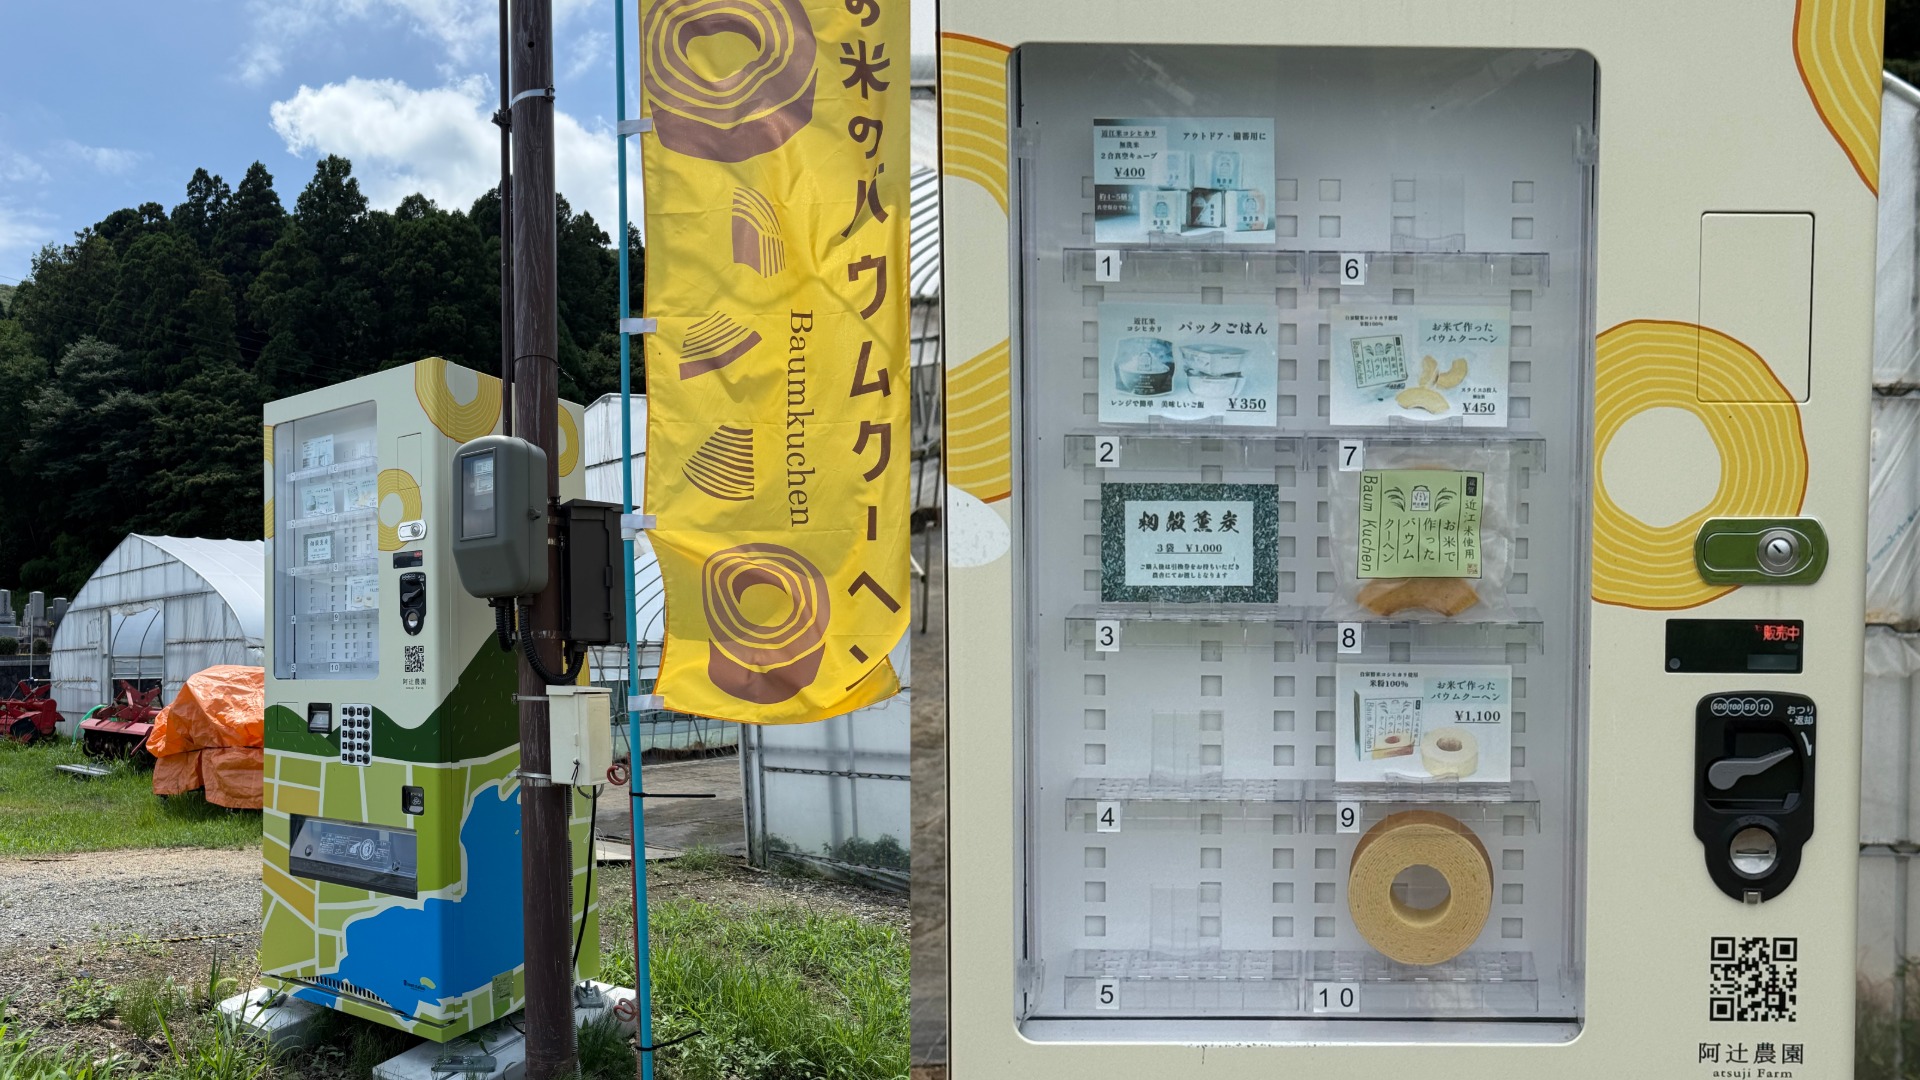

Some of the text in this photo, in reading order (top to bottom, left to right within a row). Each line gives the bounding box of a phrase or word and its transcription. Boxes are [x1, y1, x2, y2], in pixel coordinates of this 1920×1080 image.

[1101, 129, 1157, 138] 近江米コシヒカリ
[1114, 167, 1146, 178] ¥400
[1102, 256, 1111, 277] 1
[1345, 258, 1359, 280] 6
[1133, 317, 1156, 326] 近江米
[1178, 321, 1268, 335] パックごはん
[1432, 321, 1493, 333] お米で作った
[1426, 333, 1499, 343] バウムクーヘン
[1111, 399, 1154, 408] レンジで簡単
[1161, 400, 1205, 409] 美味しいご飯
[1228, 397, 1267, 410] ¥350
[1462, 402, 1496, 413] ¥450
[787, 309, 816, 528] Baumkuchen
[1099, 442, 1114, 462] 2
[1343, 446, 1357, 466] 7
[1361, 475, 1378, 572] Baum Kuchen
[1463, 499, 1477, 560] 近江米使用
[1383, 518, 1395, 563] クーヘン
[1402, 517, 1415, 560] バウム
[1423, 517, 1437, 561] 作った
[1442, 520, 1456, 562] お米で
[1156, 543, 1223, 554] 3袋 ¥1,000
[1100, 626, 1114, 646] 3
[1342, 627, 1356, 648] 8
[1763, 624, 1800, 641] 販売中
[1369, 679, 1409, 688] 米粉100%
[1436, 680, 1496, 691] お米で作った
[1430, 692, 1501, 702] バウムクーヘン
[1713, 703, 1770, 711] 500 100 50 10
[1786, 705, 1814, 715] おつり
[1455, 710, 1501, 723] ¥1,100
[1100, 807, 1115, 827] 4
[1341, 807, 1355, 827] 9
[1100, 985, 1114, 1004] 5
[1319, 987, 1354, 1008] 10
[1698, 1042, 1804, 1065] 阿辻農園
[1713, 1068, 1793, 1080] atsuji Farm
